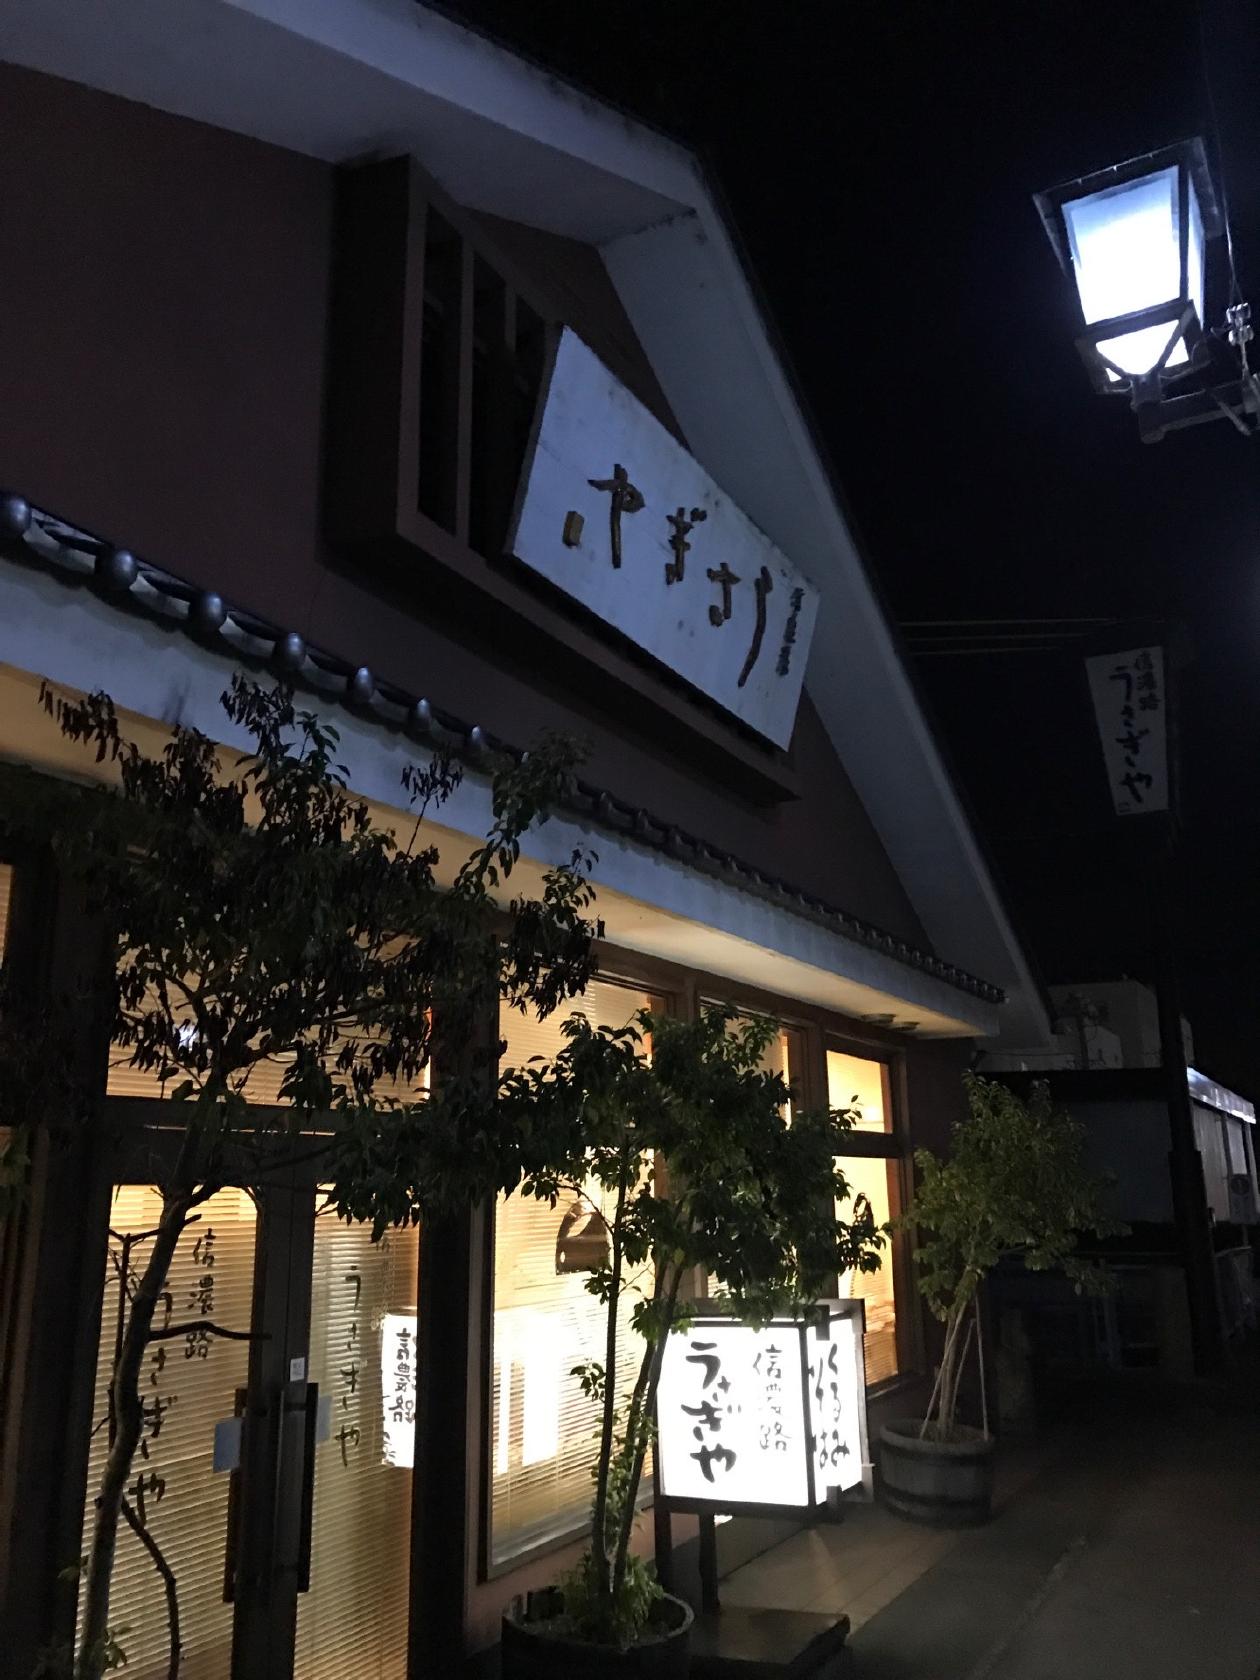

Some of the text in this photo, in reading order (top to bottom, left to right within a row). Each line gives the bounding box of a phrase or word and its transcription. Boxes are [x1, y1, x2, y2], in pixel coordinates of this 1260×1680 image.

[1109, 665, 1152, 803] うさぎや
[185, 1228, 215, 1360] 信濃路
[681, 1341, 742, 1483] うさぎや
[753, 1344, 792, 1451] 信濃路
